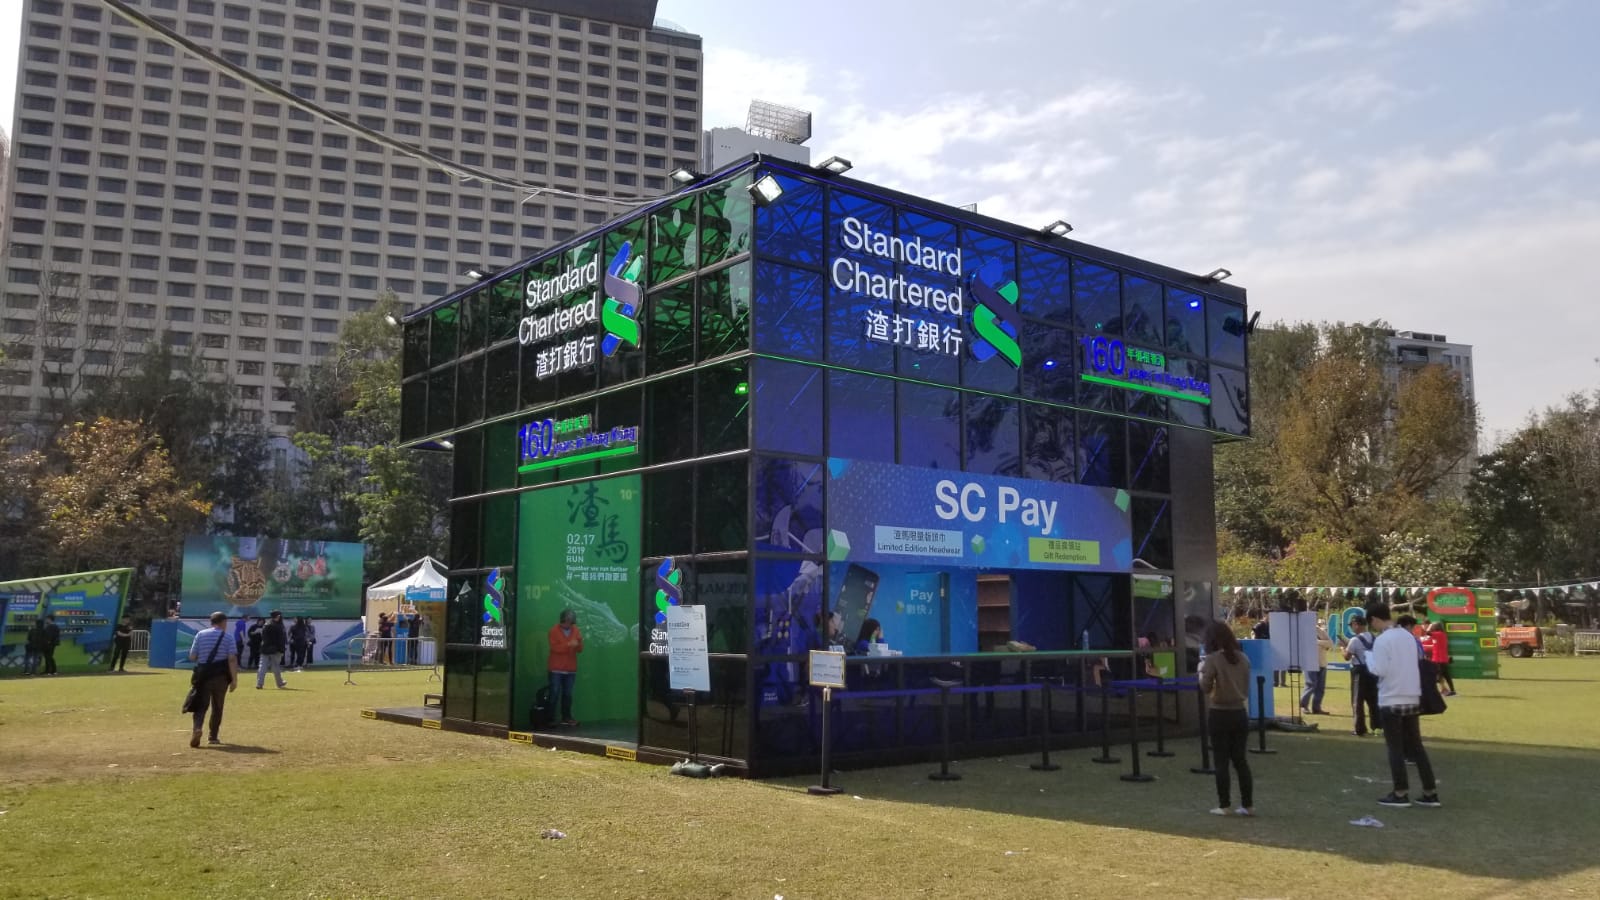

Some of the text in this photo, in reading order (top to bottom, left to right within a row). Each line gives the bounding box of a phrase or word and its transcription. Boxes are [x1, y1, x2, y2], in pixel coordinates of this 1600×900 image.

[843, 216, 962, 277] Standard
[526, 253, 598, 307] Standard
[832, 256, 963, 316] Chartered
[518, 291, 597, 345] Chartered
[865, 309, 963, 356] 渣打銀行
[535, 335, 596, 378] 渣打銀行
[1080, 336, 1125, 375] 160
[518, 418, 553, 460] 160
[585, 431, 609, 447] Hong
[611, 425, 636, 443] Kong
[935, 480, 1058, 535] SC Pay
[567, 533, 595, 545] 02.17
[567, 546, 585, 555] 2019
[877, 542, 961, 554] Limited Edition Headwear
[566, 555, 584, 563] RUN
[1043, 551, 1087, 562] Gift Redemption
[910, 589, 934, 603] Pay
[480, 636, 504, 647] Chartered
[481, 625, 504, 636] Standard
